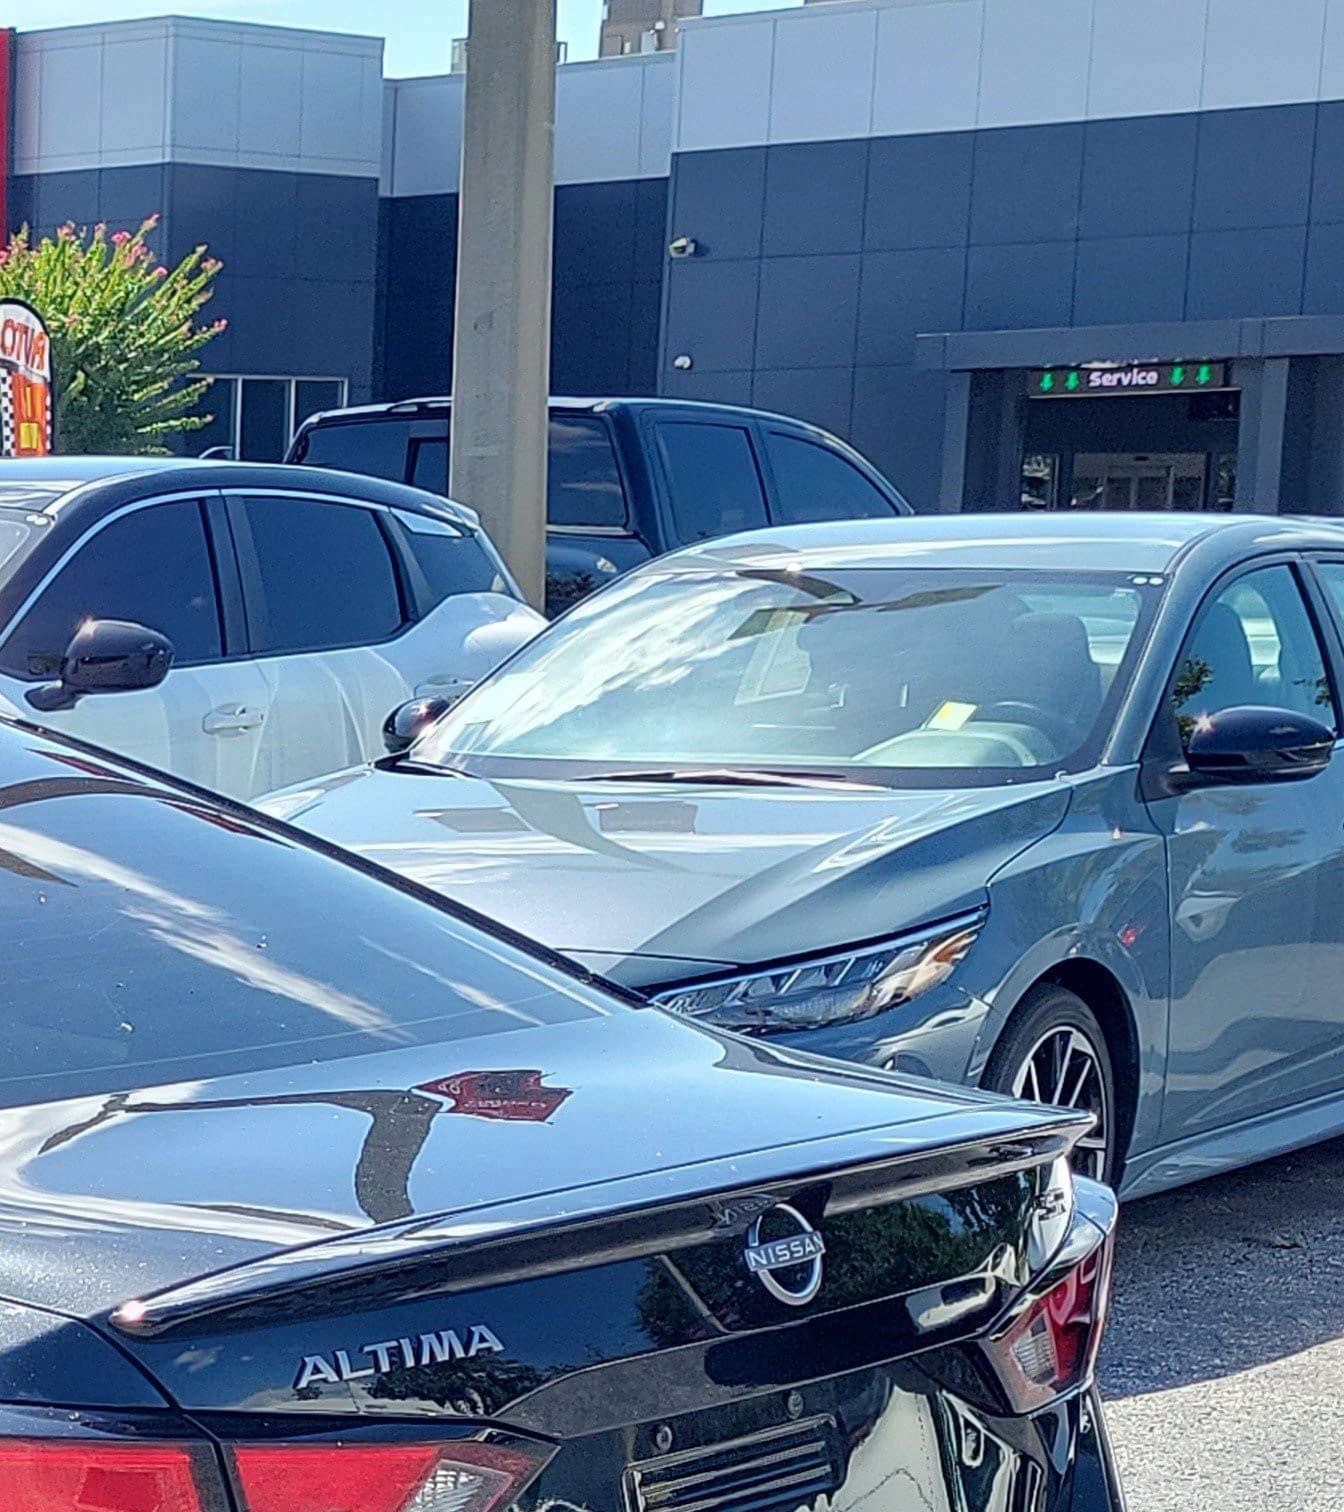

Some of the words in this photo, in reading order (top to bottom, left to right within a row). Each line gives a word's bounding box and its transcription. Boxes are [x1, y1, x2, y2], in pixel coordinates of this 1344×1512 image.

[1088, 368, 1159, 387] Service
[748, 1234, 824, 1266] NISSAN
[292, 1323, 505, 1390] ALTIMA
